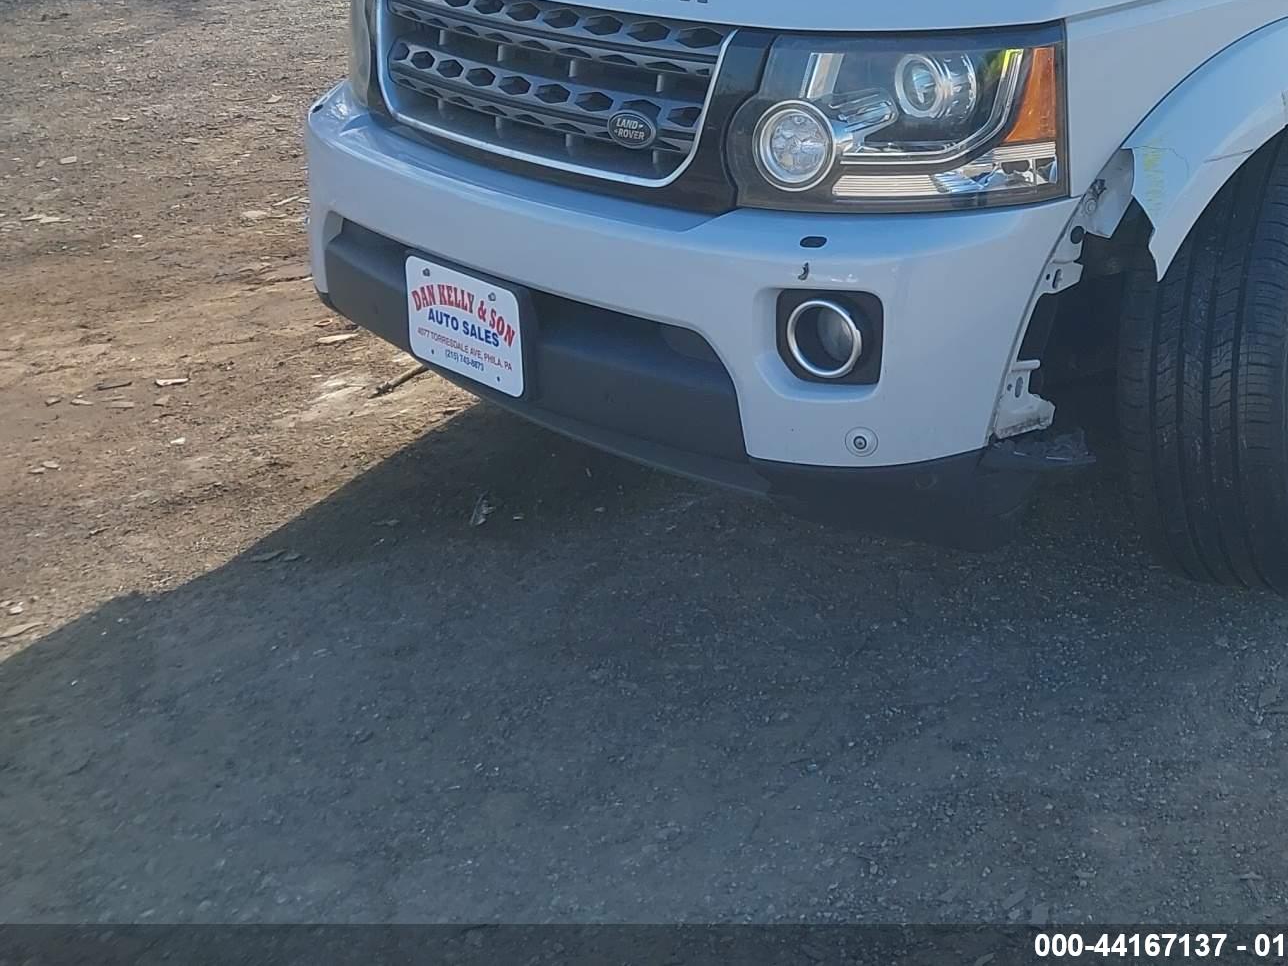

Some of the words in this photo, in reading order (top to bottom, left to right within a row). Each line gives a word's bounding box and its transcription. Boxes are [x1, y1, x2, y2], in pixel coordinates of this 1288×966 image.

[616, 118, 639, 130] LAND
[617, 129, 645, 141] ROVER
[411, 284, 436, 311] DAN
[438, 284, 475, 314] KELLY
[477, 300, 487, 322] &
[489, 308, 516, 347] SON
[428, 308, 459, 331] AUTO
[462, 321, 500, 347] SALES
[504, 360, 513, 371] PA
